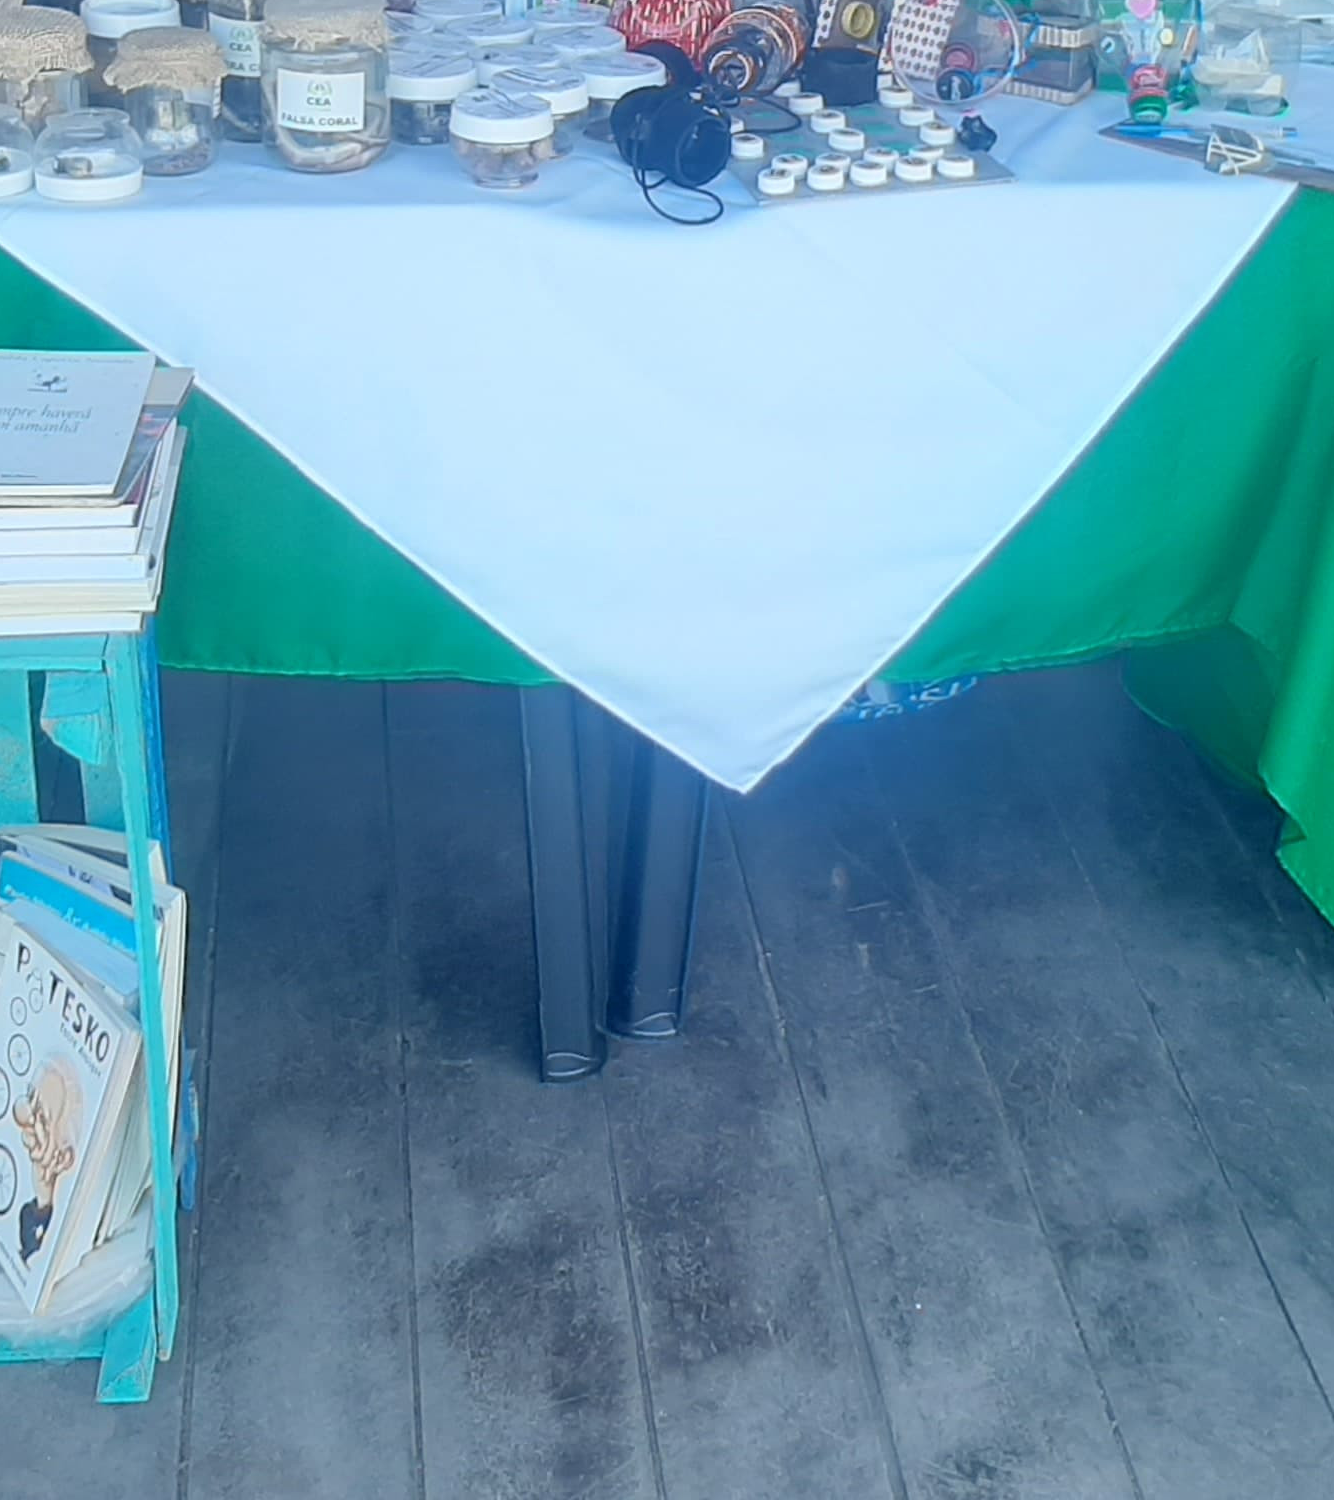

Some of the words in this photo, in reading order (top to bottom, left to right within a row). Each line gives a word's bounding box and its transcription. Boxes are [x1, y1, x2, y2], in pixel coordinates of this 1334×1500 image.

[228, 41, 253, 53] CEA
[306, 96, 332, 106] CEA
[280, 111, 316, 127] FALSA
[318, 116, 359, 127] CORAL
[40, 403, 94, 420] haverá
[14, 419, 81, 434] amanhã
